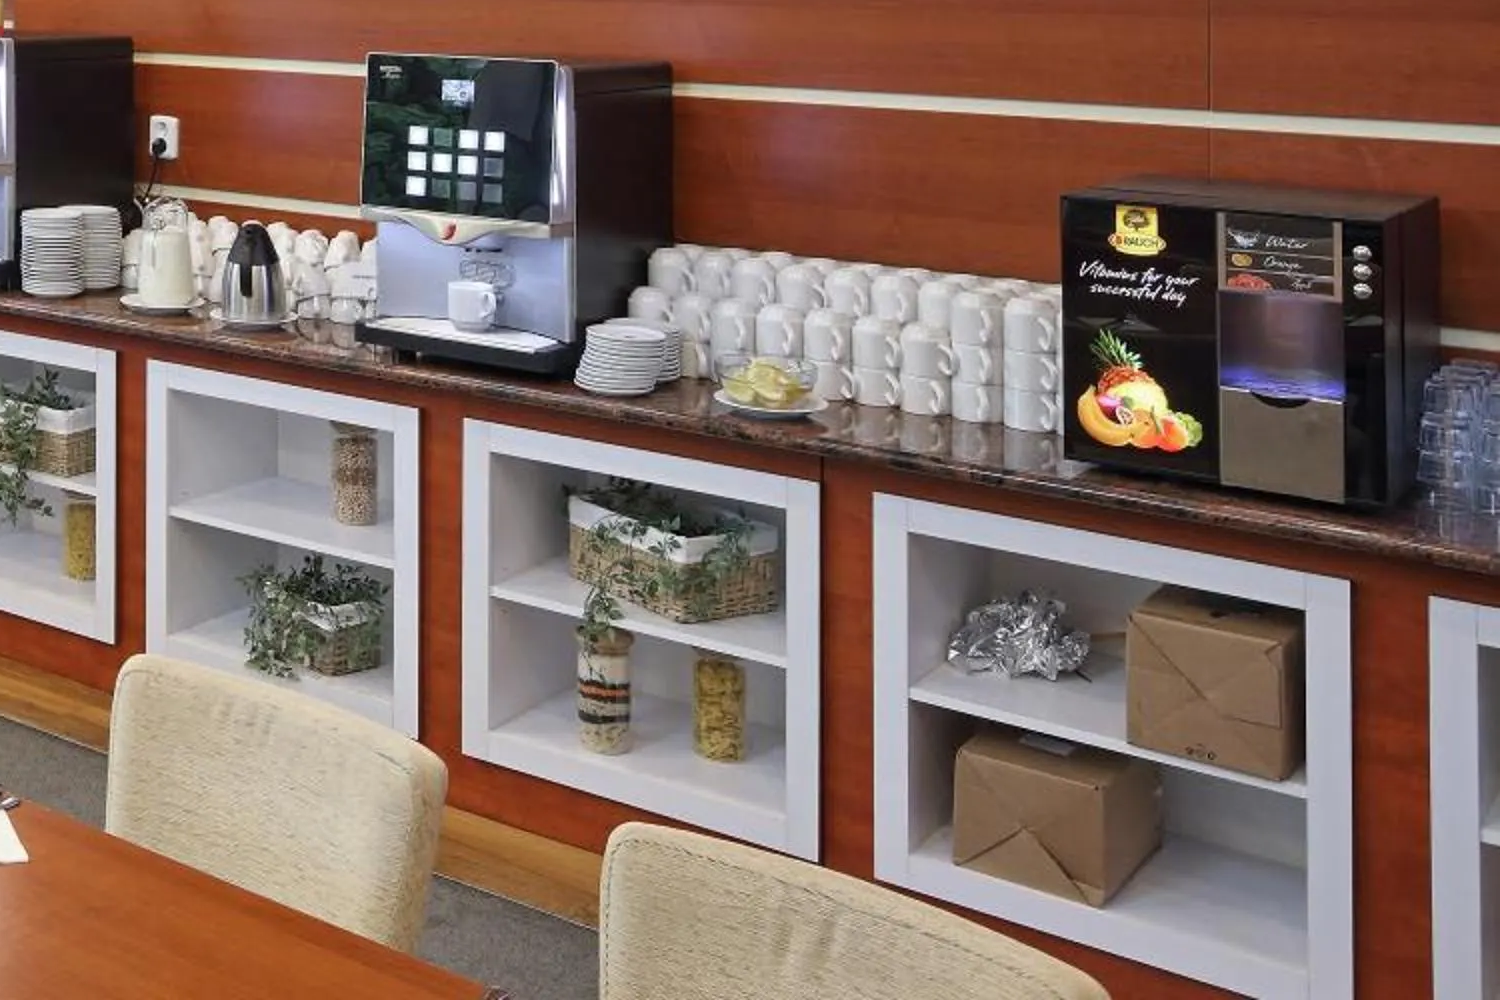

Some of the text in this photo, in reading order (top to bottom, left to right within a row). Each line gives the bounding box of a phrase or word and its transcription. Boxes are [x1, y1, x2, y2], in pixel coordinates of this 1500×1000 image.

[1124, 236, 1159, 249] RAUCH
[1079, 260, 1200, 290] Vitamins for your
[1089, 283, 1187, 308] successful day
